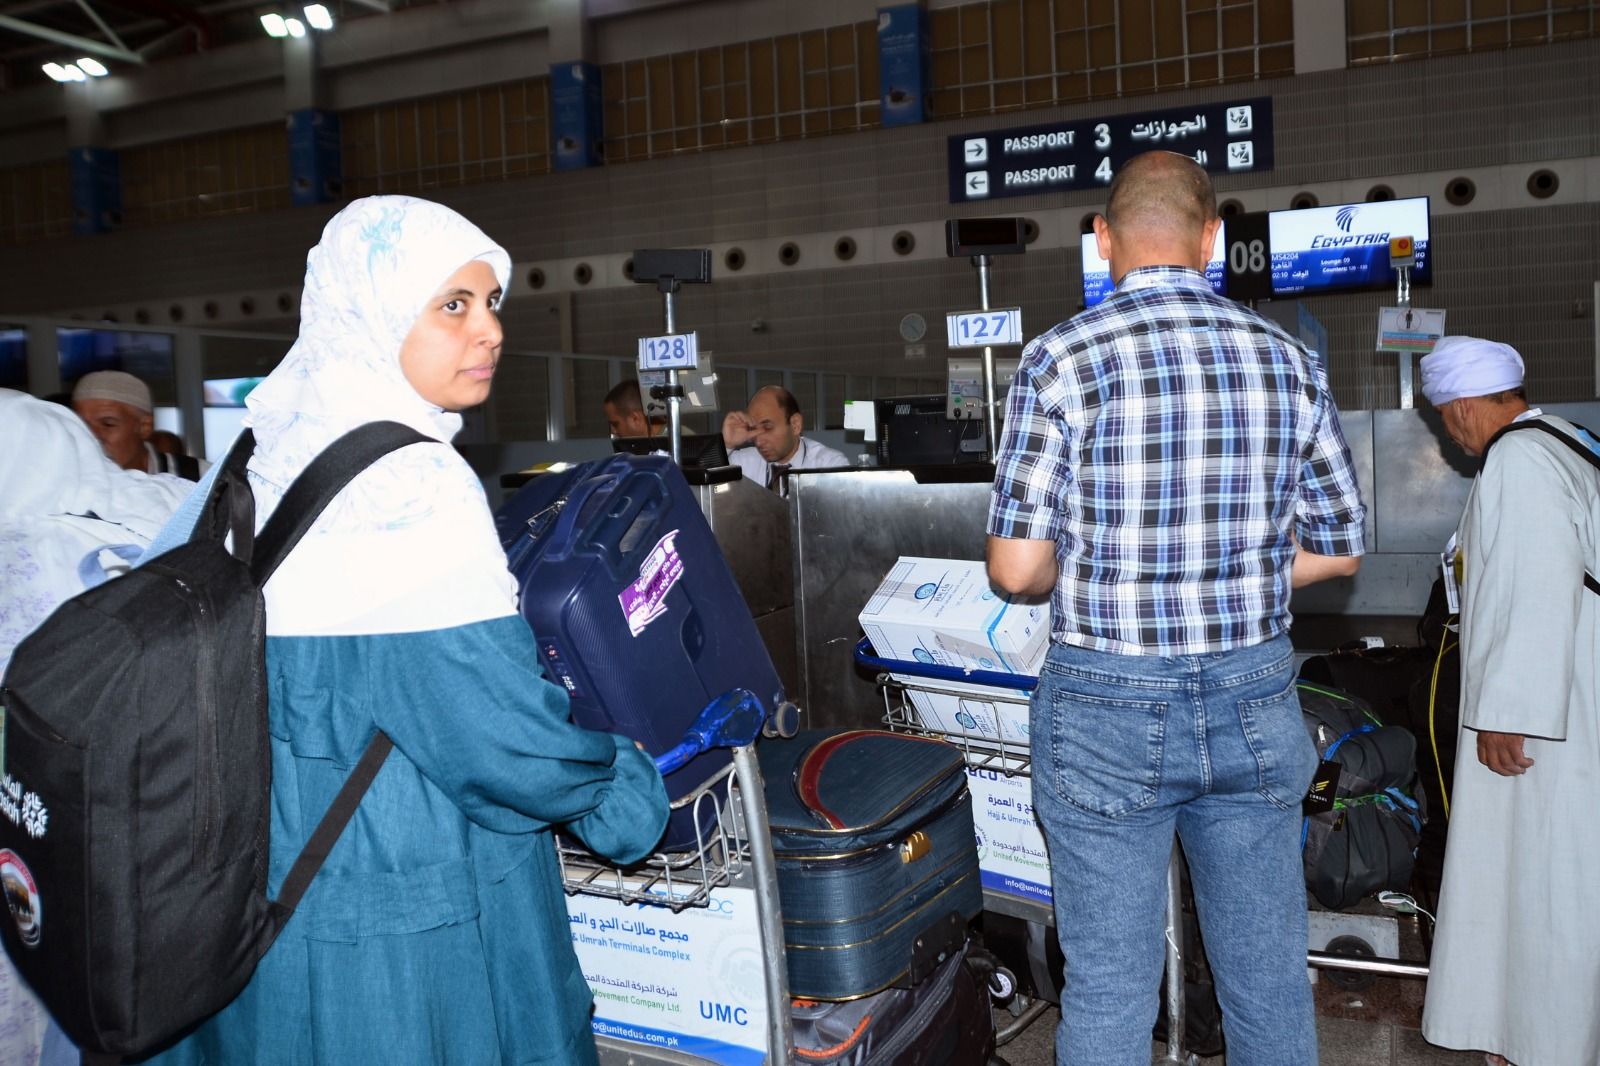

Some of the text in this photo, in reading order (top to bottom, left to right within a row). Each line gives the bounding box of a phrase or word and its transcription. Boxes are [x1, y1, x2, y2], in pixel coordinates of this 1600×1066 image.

[1130, 115, 1207, 139] الجوازات
[1003, 123, 1111, 152] PASSPORT 3
[1004, 156, 1112, 185] PASSPORT 4
[1311, 232, 1390, 249] EGYPTAIR
[1230, 239, 1266, 274] 08
[1271, 252, 1299, 261] MS4204
[1271, 260, 1293, 270] القاهرة
[1272, 271, 1289, 279] 02:10
[1292, 270, 1309, 278] الوقت
[960, 315, 1007, 338] 127
[648, 338, 685, 360] 128
[988, 794, 1014, 808] العمرة
[1016, 802, 1022, 811] و
[987, 810, 1000, 821] Hajj
[1001, 812, 1007, 820] &
[1007, 814, 1031, 827] Umrah
[993, 850, 1013, 861] United
[1013, 855, 1045, 870] Movement
[589, 918, 597, 929] و
[599, 916, 619, 932] الحج
[621, 920, 656, 936] صالات
[659, 928, 689, 942] مجمع
[579, 933, 608, 947] Umrah
[608, 937, 651, 955] Terminals
[651, 945, 691, 961] Complex
[601, 975, 630, 989] المتحدة
[631, 980, 655, 994] الحركة
[591, 987, 682, 1013] Movement Company Ltd.
[655, 987, 678, 997] شركة
[700, 1000, 748, 1026] UMC
